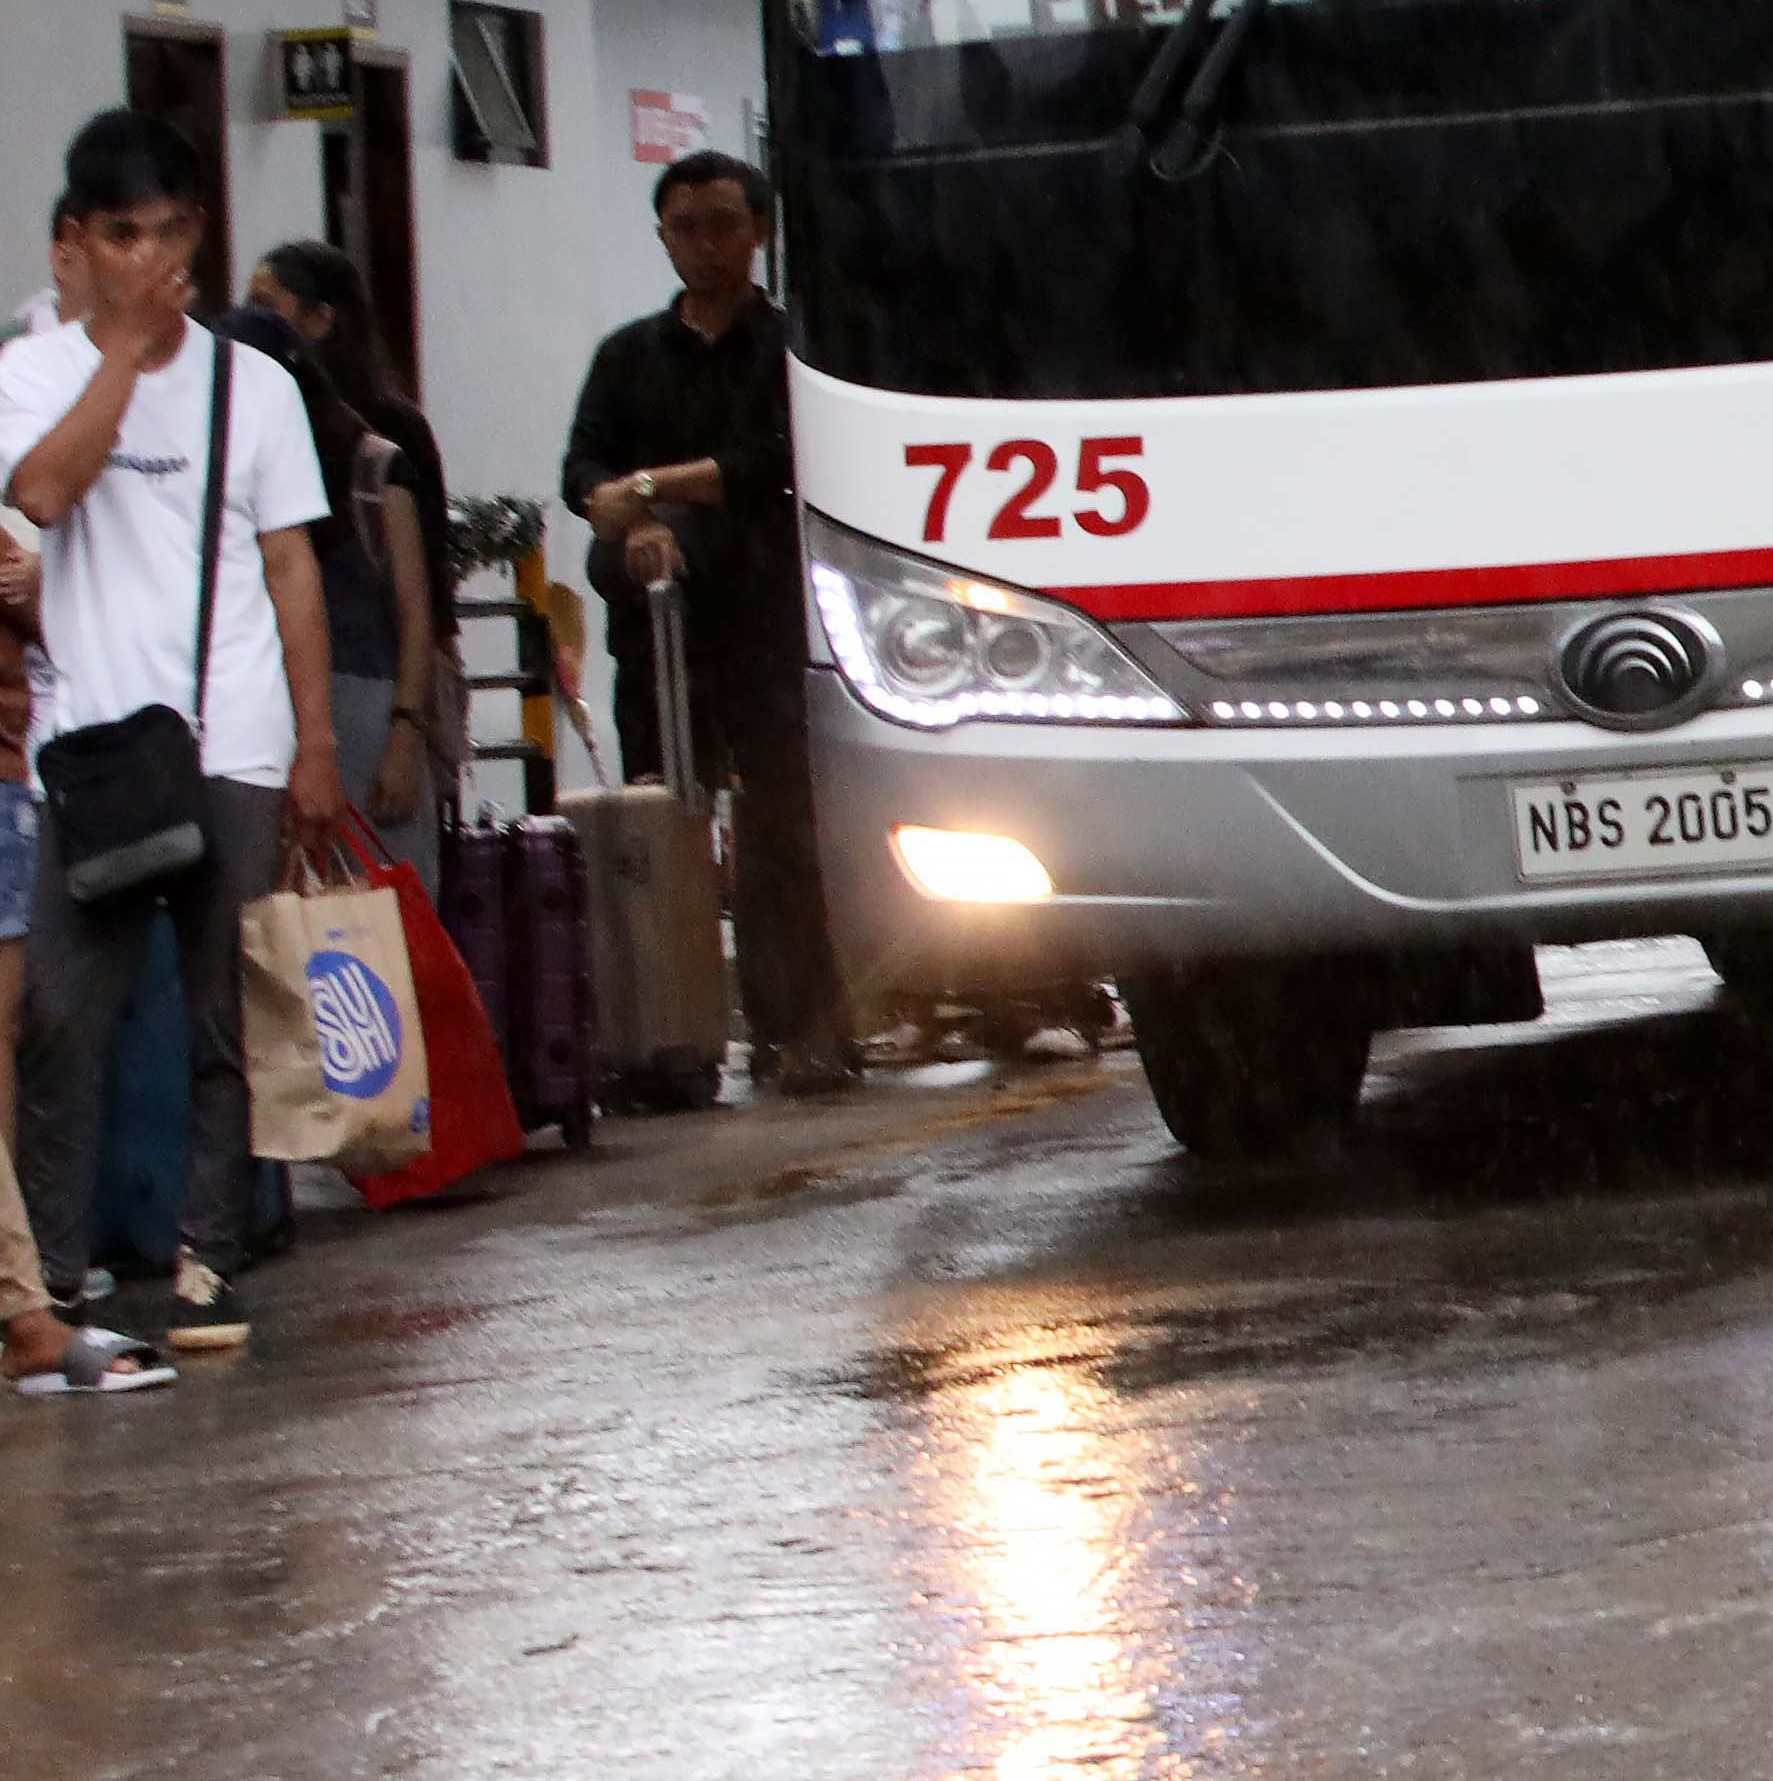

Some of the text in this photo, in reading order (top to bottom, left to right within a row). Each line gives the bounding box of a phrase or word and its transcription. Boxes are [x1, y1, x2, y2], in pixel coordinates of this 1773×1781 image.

[904, 435, 1151, 543] 725
[1529, 786, 1772, 853] NBS 2005
